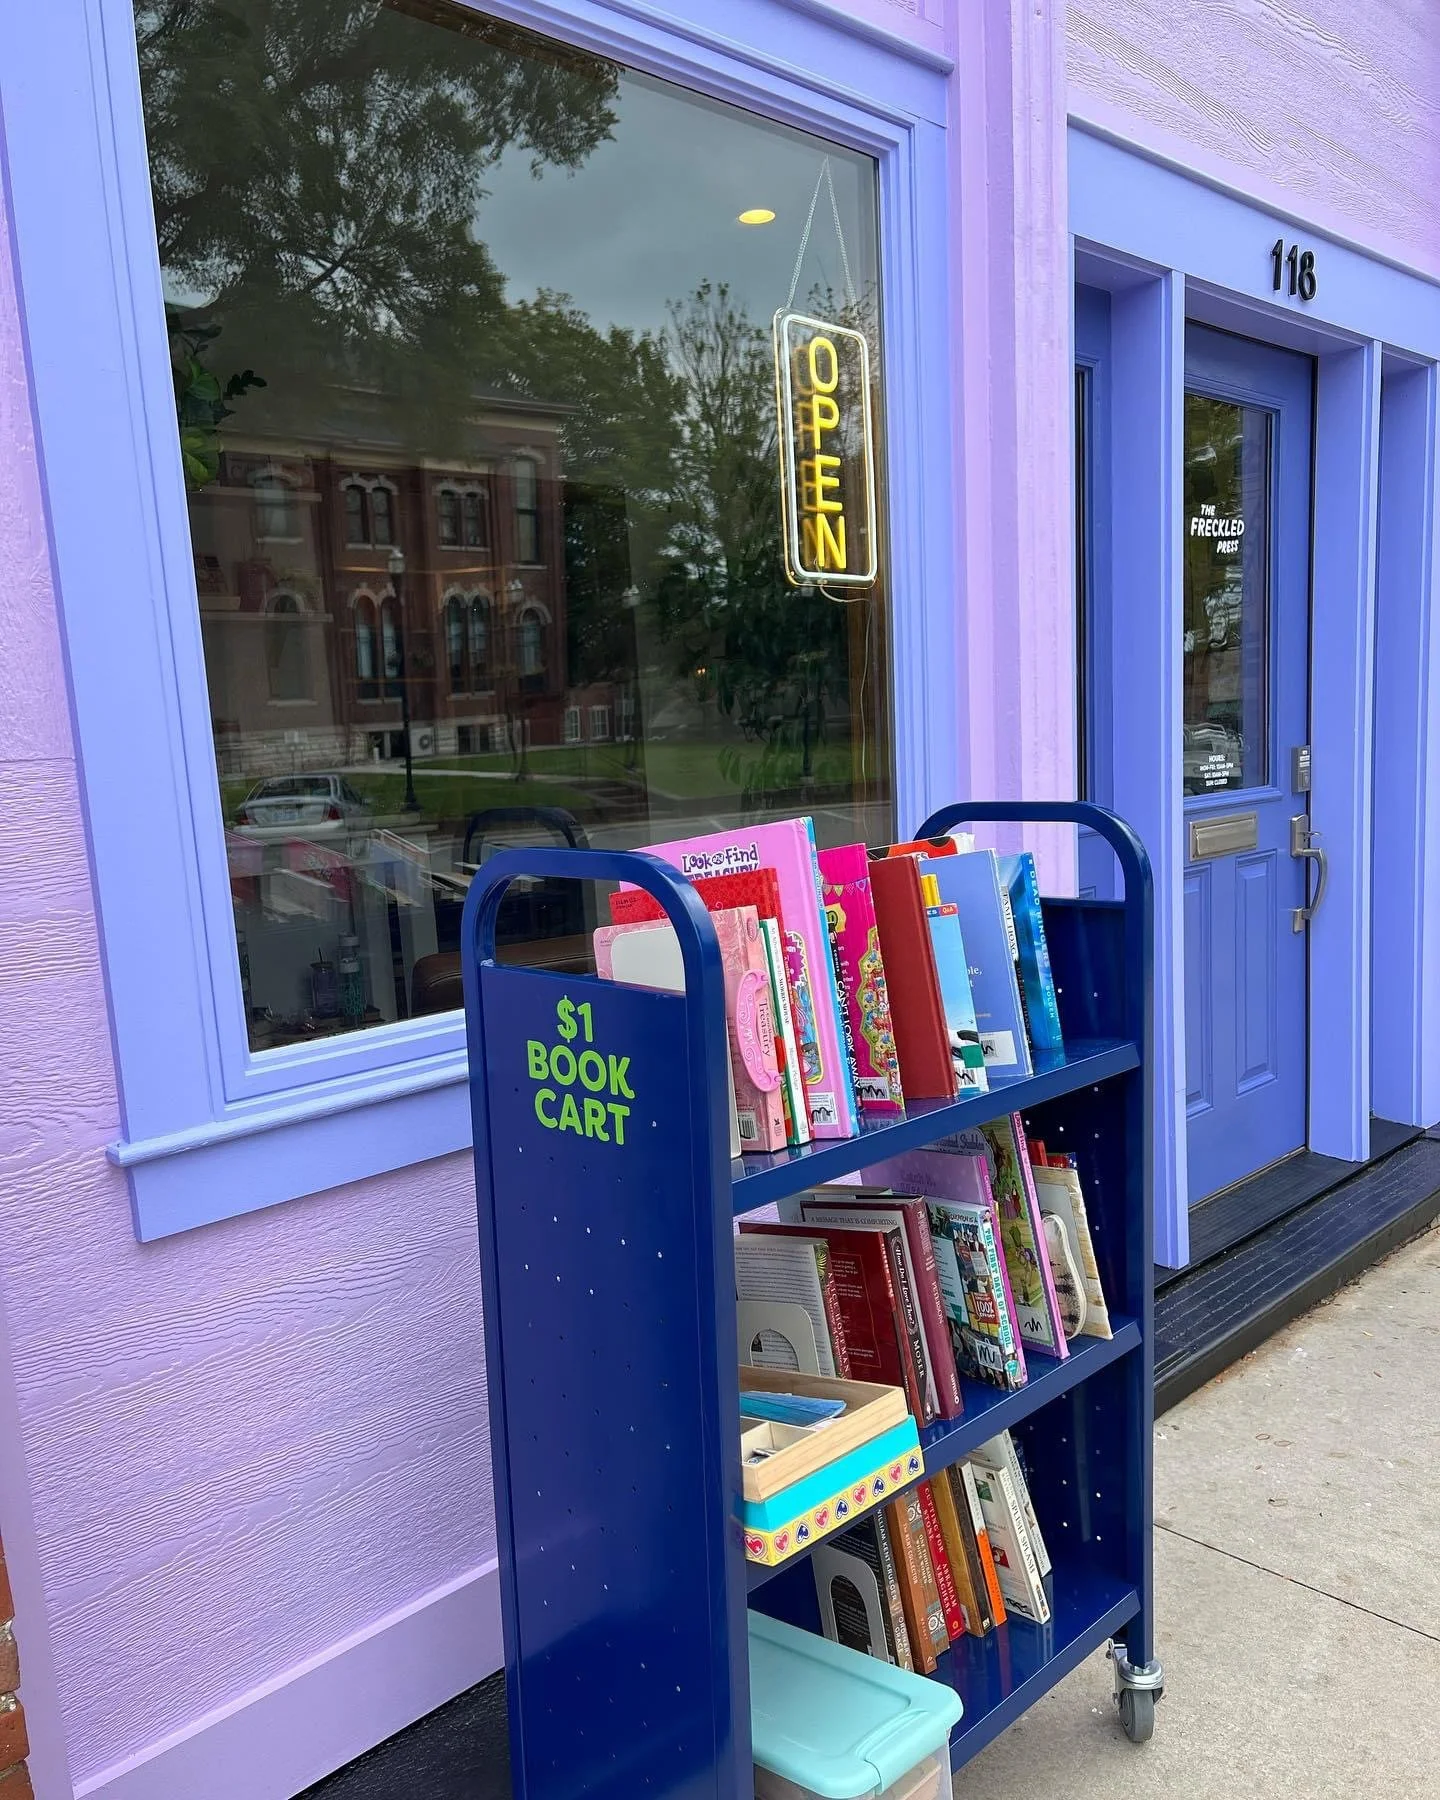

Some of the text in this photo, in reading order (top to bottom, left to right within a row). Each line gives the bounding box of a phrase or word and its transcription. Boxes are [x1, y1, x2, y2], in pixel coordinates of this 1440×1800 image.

[1270, 239, 1316, 300] 118
[809, 336, 846, 569] OPEN
[1190, 518, 1244, 537] FRECKLED
[1200, 504, 1215, 516] THE
[1217, 540, 1239, 553] PRESS
[682, 855, 712, 872] Look
[725, 843, 758, 864] Find
[1029, 870, 1040, 905] DEAD
[835, 980, 849, 1016] CAN'T
[557, 995, 593, 1043] $1
[759, 1000, 771, 1057] Treasury
[842, 1019, 855, 1052] LOOK
[527, 1040, 635, 1099] BOOK
[848, 1056, 861, 1089] AWAY
[535, 1088, 630, 1145] CART
[894, 1248, 904, 1266] How
[898, 1267, 907, 1279] Do
[901, 1286, 912, 1303] Love
[984, 1228, 1012, 1348] THE FIRST DAYS OF SCHOOL
[827, 1271, 838, 1310] ALICE
[834, 1313, 849, 1372] HOFFMAN
[913, 1339, 925, 1377] MOSER
[924, 1487, 944, 1553] CUTTING FOR
[924, 1509, 934, 1541] STONE
[1010, 1499, 1024, 1533] SPLISH
[1021, 1535, 1036, 1574] SPLASH
[881, 1544, 890, 1564] KENT
[886, 1564, 897, 1602] KRUEGER
[908, 1550, 918, 1585] COLLECTOR
[942, 1562, 957, 1608] ABRAHAM
[936, 1564, 951, 1615] VERGHESE
[898, 1616, 911, 1658] ORDINARY
